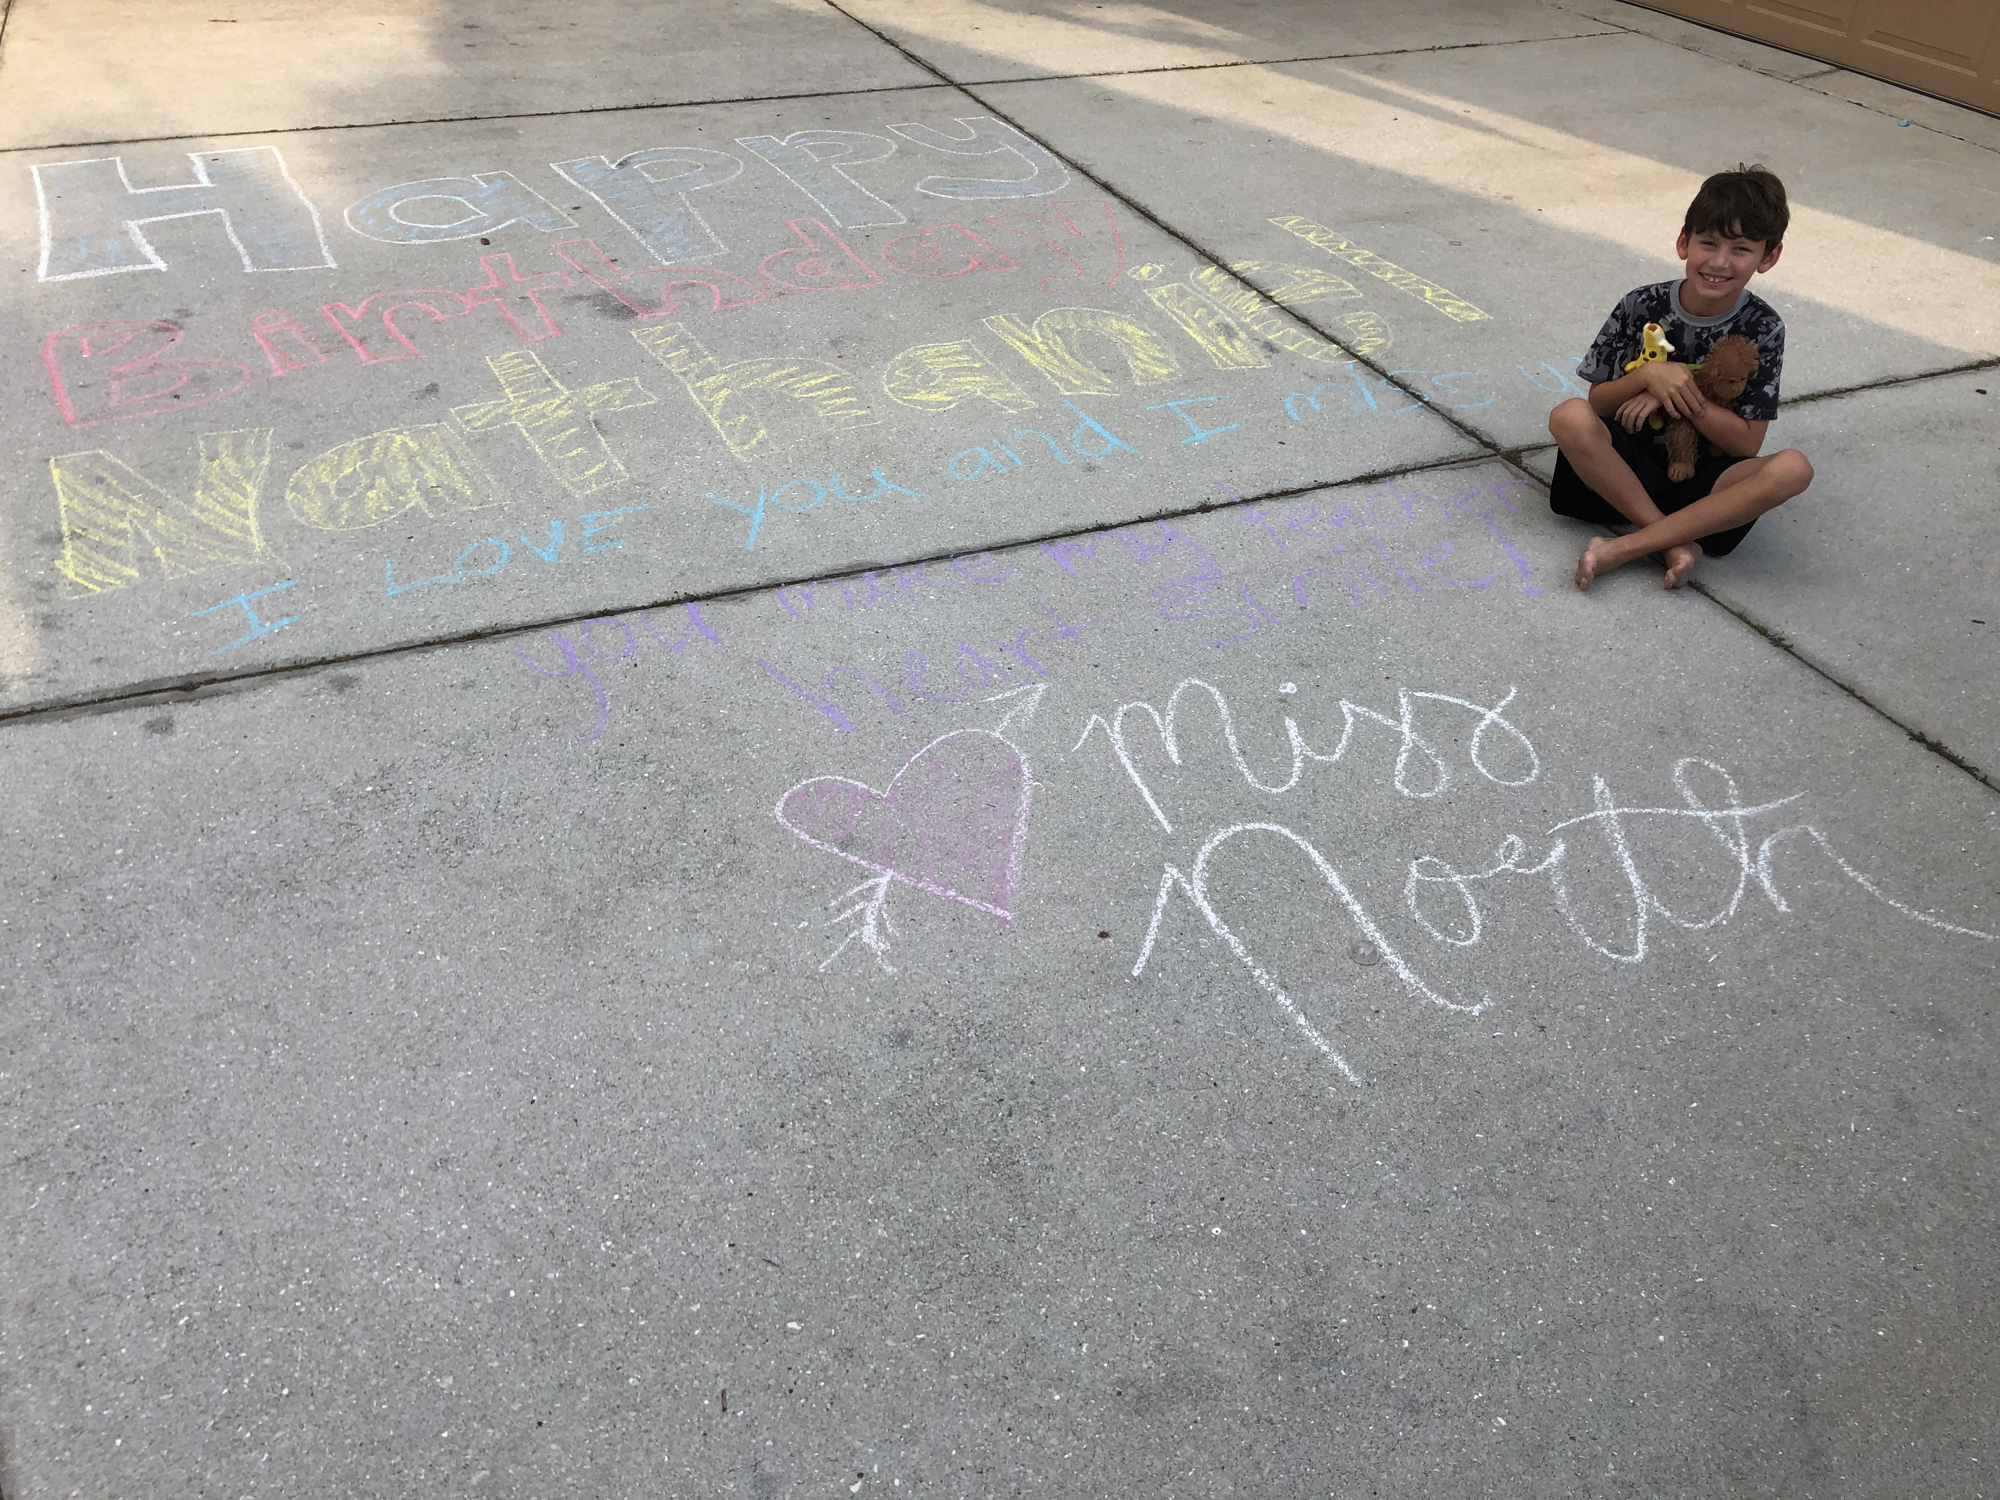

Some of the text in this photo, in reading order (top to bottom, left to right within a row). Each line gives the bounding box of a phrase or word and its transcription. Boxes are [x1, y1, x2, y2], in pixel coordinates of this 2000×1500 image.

[31, 116, 1071, 283] Happy
[42, 199, 1126, 428] Birthday
[192, 578, 301, 656] I
[949, 399, 1139, 481] and
[1147, 395, 1239, 444] I
[1284, 361, 1495, 421] miss
[776, 550, 1016, 620] make
[1040, 520, 1221, 602] my
[1215, 477, 1531, 555] teacher
[756, 598, 1100, 733] heart
[1131, 756, 1999, 1087] North
